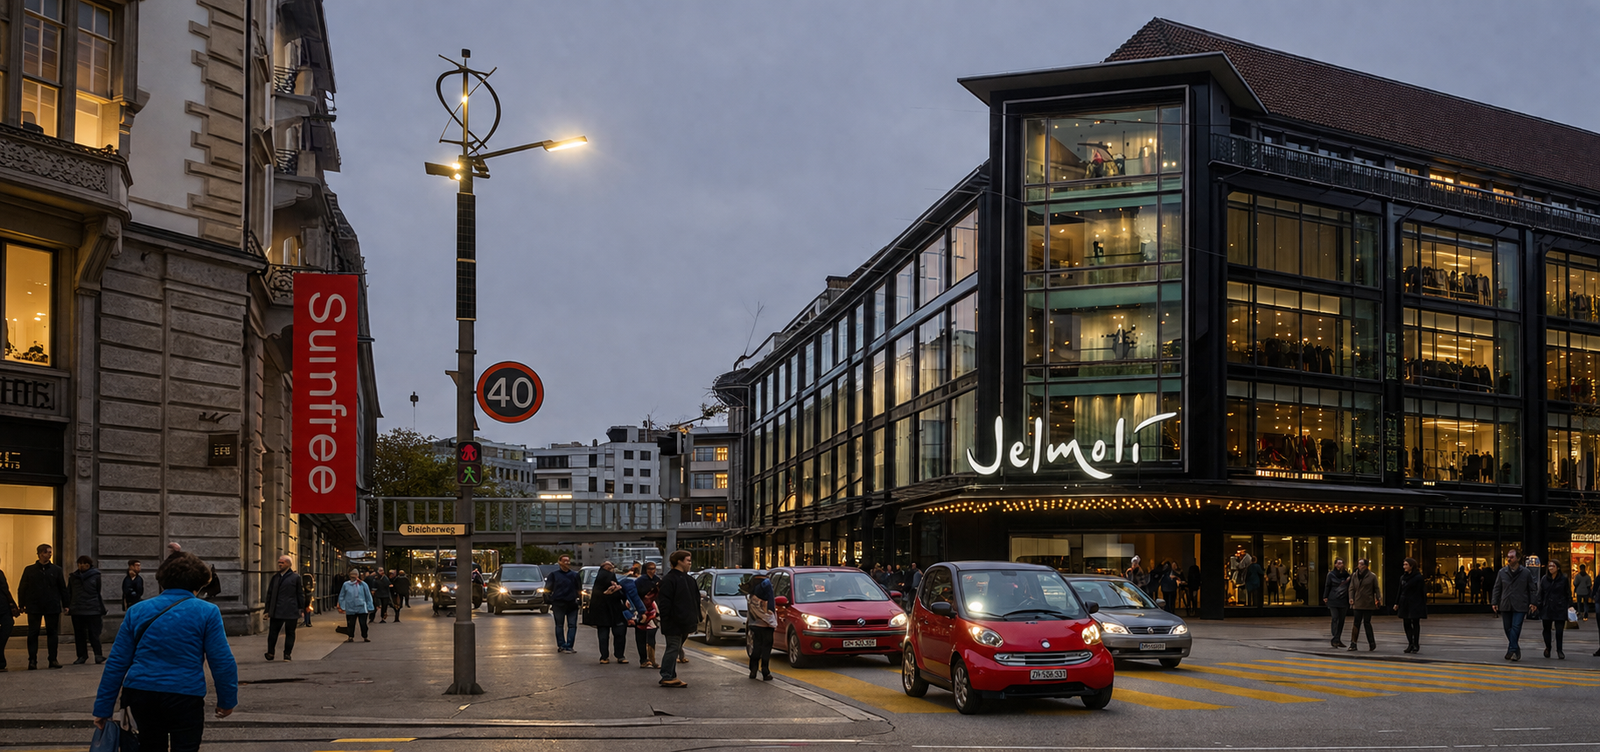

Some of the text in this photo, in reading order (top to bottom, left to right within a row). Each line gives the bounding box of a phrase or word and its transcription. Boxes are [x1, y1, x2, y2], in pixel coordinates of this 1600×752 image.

[487, 377, 533, 409] 40
[966, 412, 1177, 480] Jelmoli
[407, 525, 456, 535] Bleicherweg
